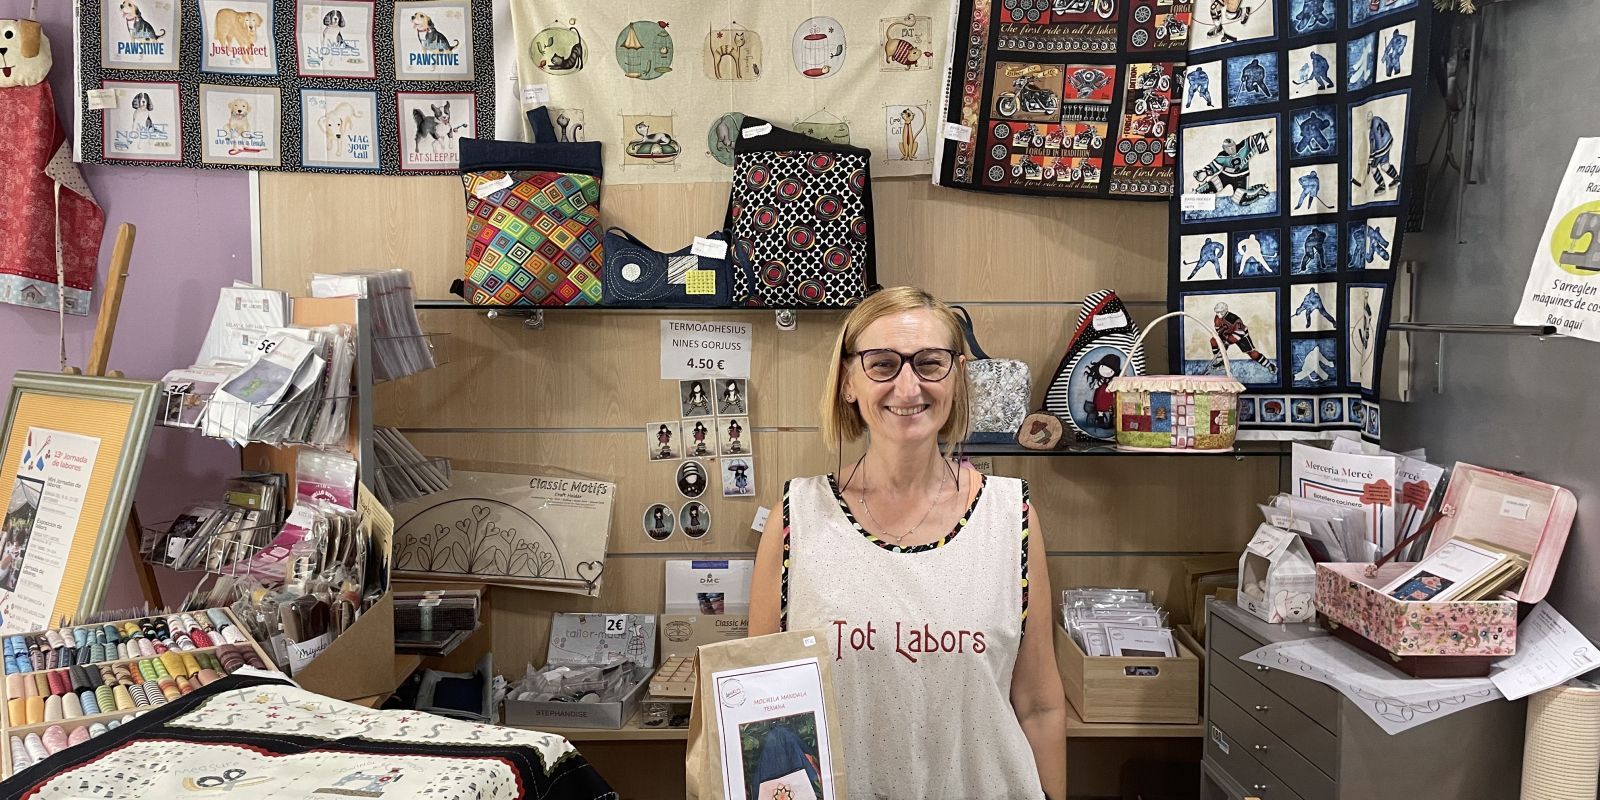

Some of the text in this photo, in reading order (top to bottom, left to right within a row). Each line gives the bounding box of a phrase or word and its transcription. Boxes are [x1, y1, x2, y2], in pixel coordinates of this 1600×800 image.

[1001, 23, 1018, 33] The
[1020, 24, 1041, 35] first
[1043, 25, 1061, 34] ride
[118, 42, 164, 55] PAWSITIVE
[210, 44, 268, 58] Just pawfect
[308, 47, 360, 57] NOSES
[409, 53, 459, 66] PAWSITIVE
[116, 130, 168, 140] NOSES
[348, 142, 369, 154] your
[1061, 149, 1091, 157] TRADITION
[410, 152, 459, 162] EAT SLEEP PL
[1113, 167, 1131, 177] The
[1133, 167, 1154, 179] first
[1552, 279, 1597, 297] S'arreglen
[1574, 297, 1586, 310] de
[669, 321, 746, 334] TERMOADHESIUS
[1563, 319, 1584, 332] aquí
[258, 339, 275, 353] 5€
[672, 339, 741, 350] NINES GORJUSS
[687, 358, 725, 370] 4.50 €
[1305, 459, 1373, 480] Merceria Mercè
[529, 477, 608, 495] Classic Motifs
[607, 619, 624, 631] 2€
[715, 619, 739, 627] Classic
[833, 620, 986, 663] Tot Labors
